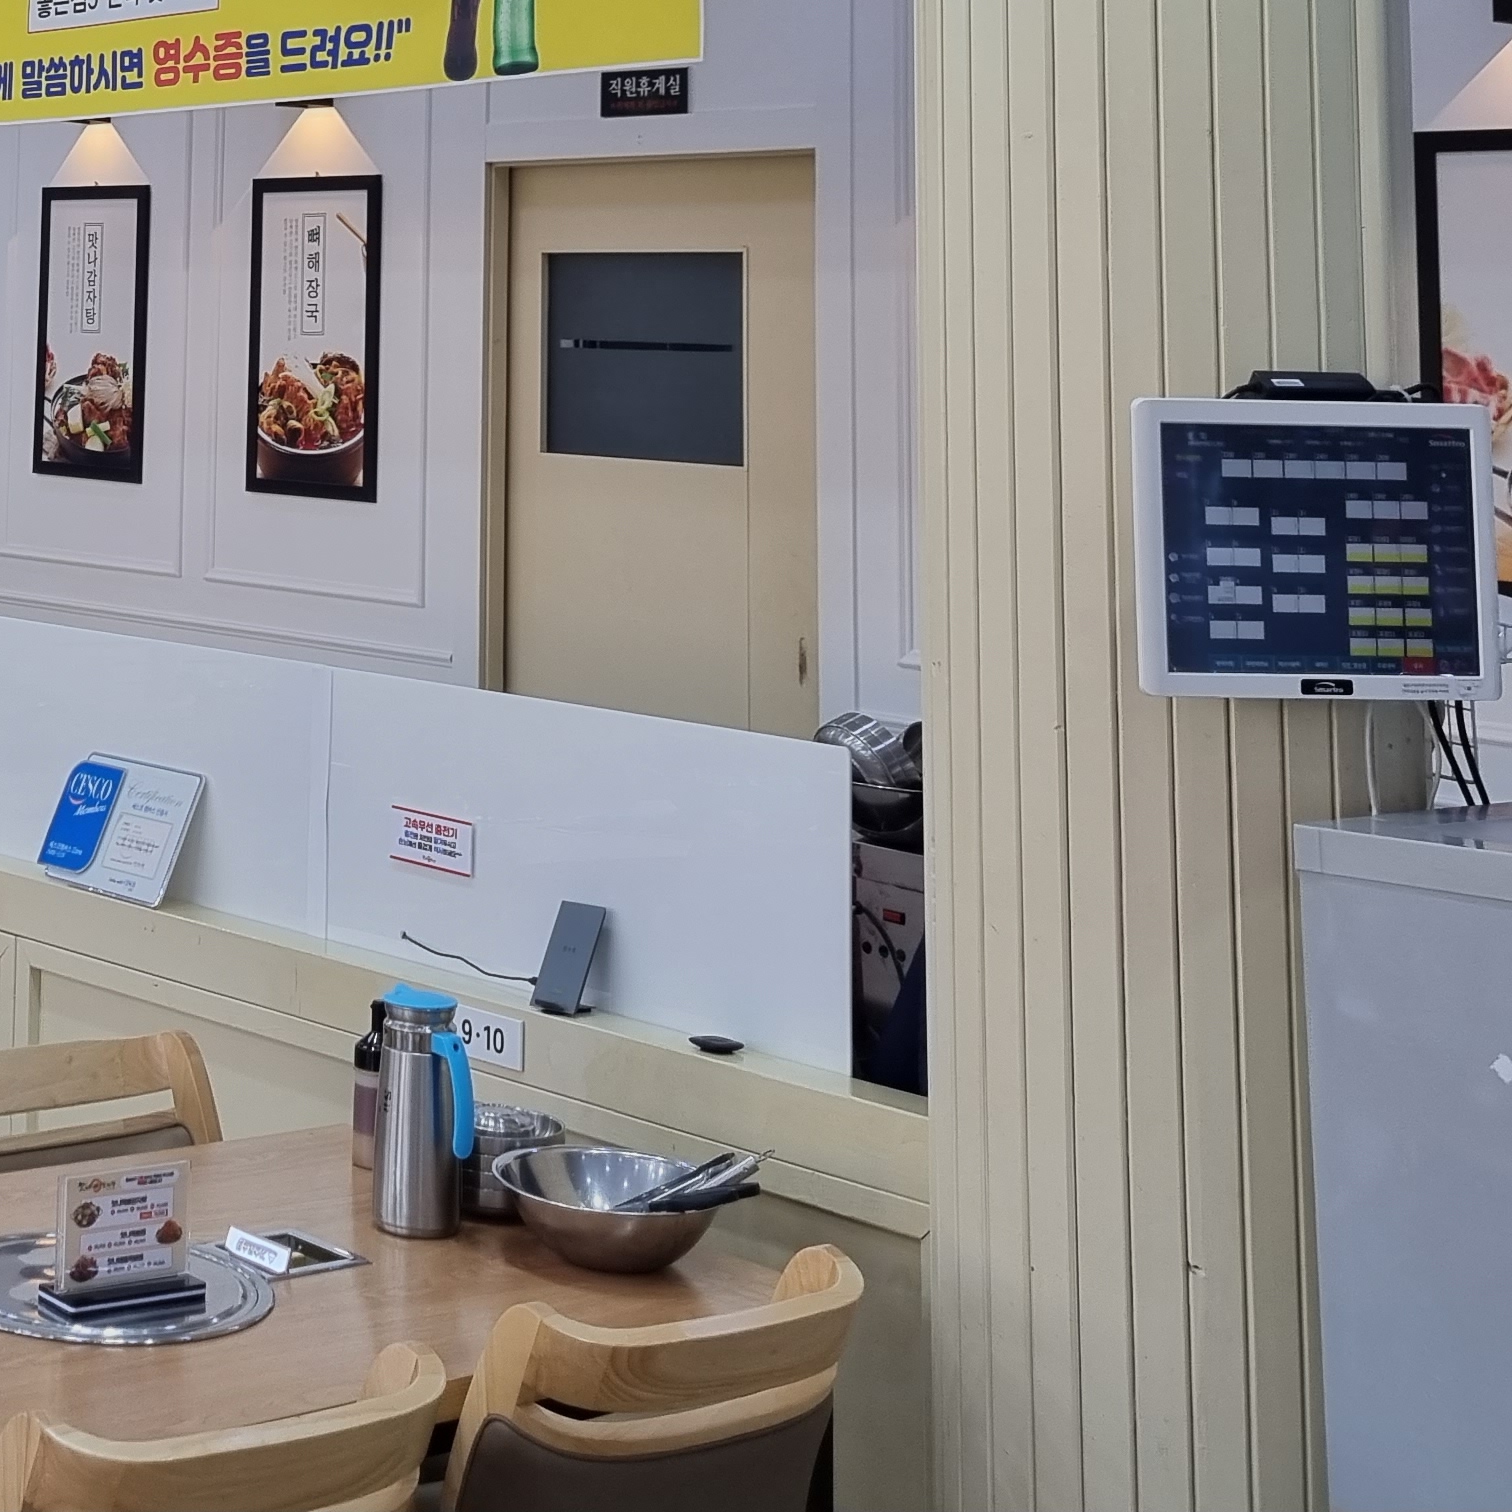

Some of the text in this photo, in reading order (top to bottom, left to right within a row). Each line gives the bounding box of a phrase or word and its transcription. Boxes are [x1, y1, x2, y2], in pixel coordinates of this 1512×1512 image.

[21, 46, 144, 101] 말씀하시면
[152, 30, 271, 88] 영수증을
[608, 74, 681, 98] 직원휴게실
[84, 230, 99, 326] 맛나감자탕
[304, 225, 322, 324] 뼈해장국
[70, 771, 113, 801] CESCO
[403, 816, 434, 834] 고속무선
